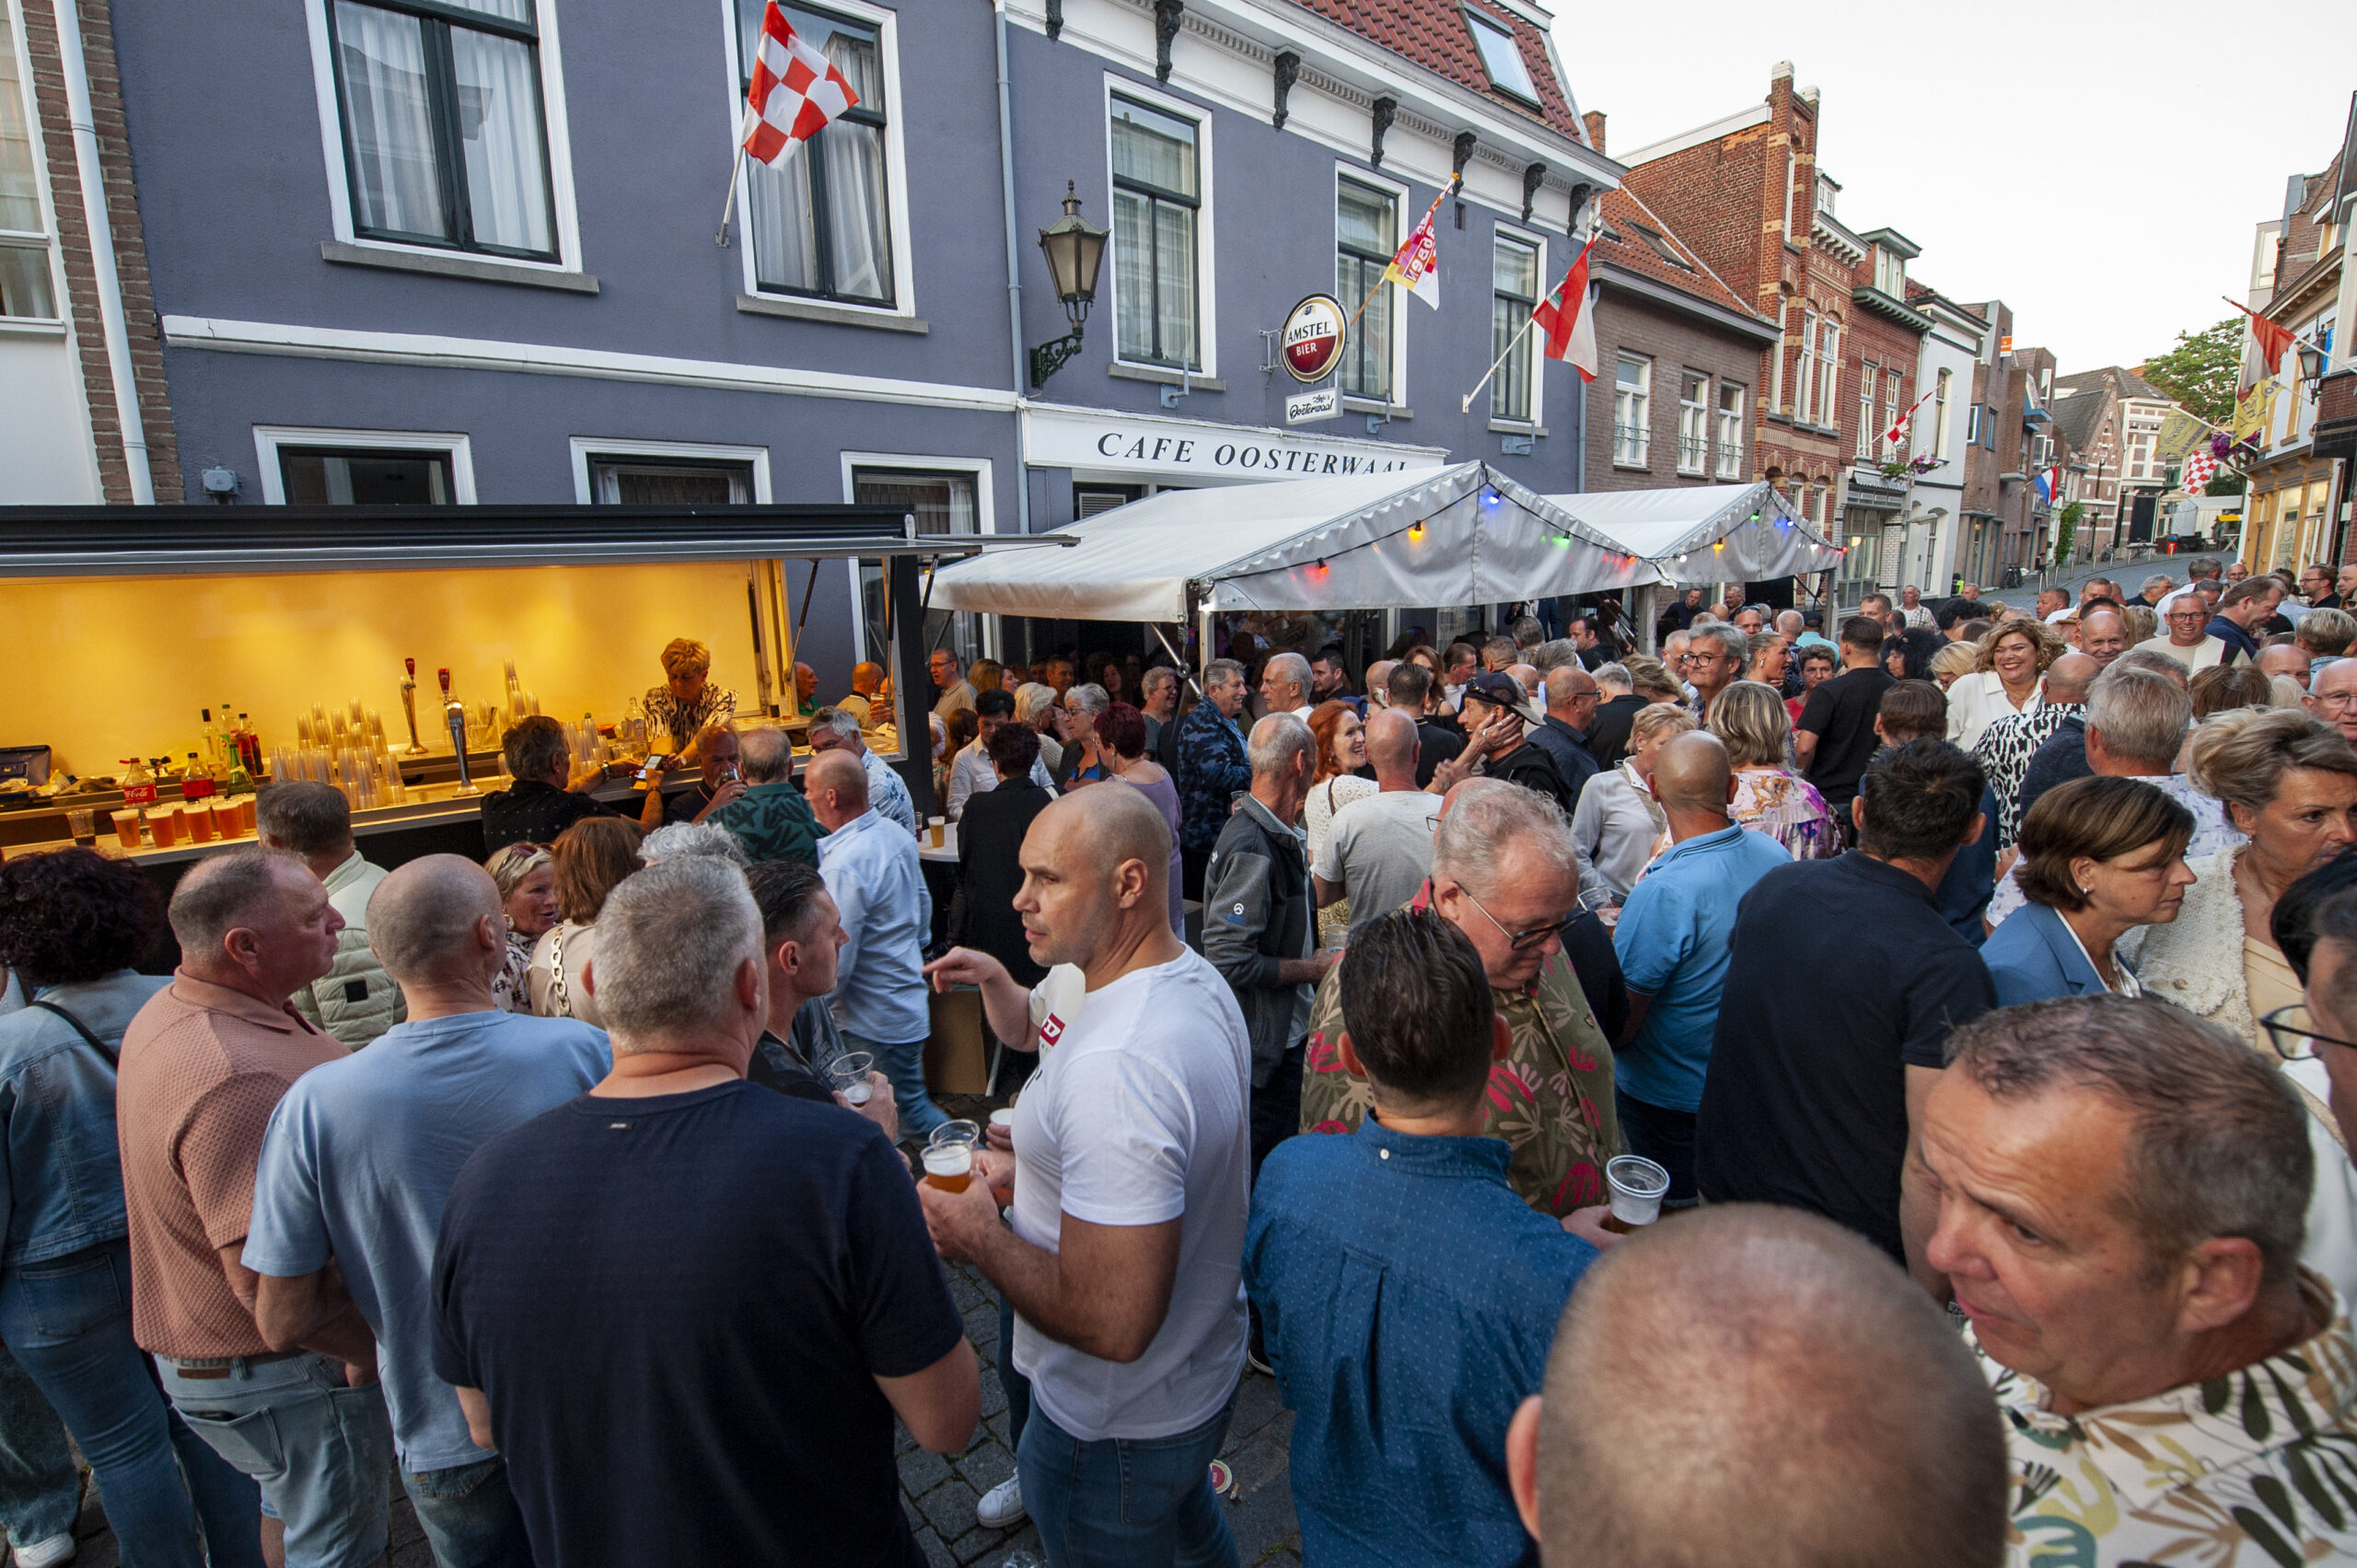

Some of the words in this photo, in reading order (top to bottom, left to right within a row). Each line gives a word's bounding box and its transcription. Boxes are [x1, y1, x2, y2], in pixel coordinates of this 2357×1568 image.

[1287, 320, 1331, 344] AMSTEL
[1295, 342, 1318, 357] BIER
[1289, 398, 1334, 420] Oosterwaal
[1097, 433, 1195, 463] CAFE
